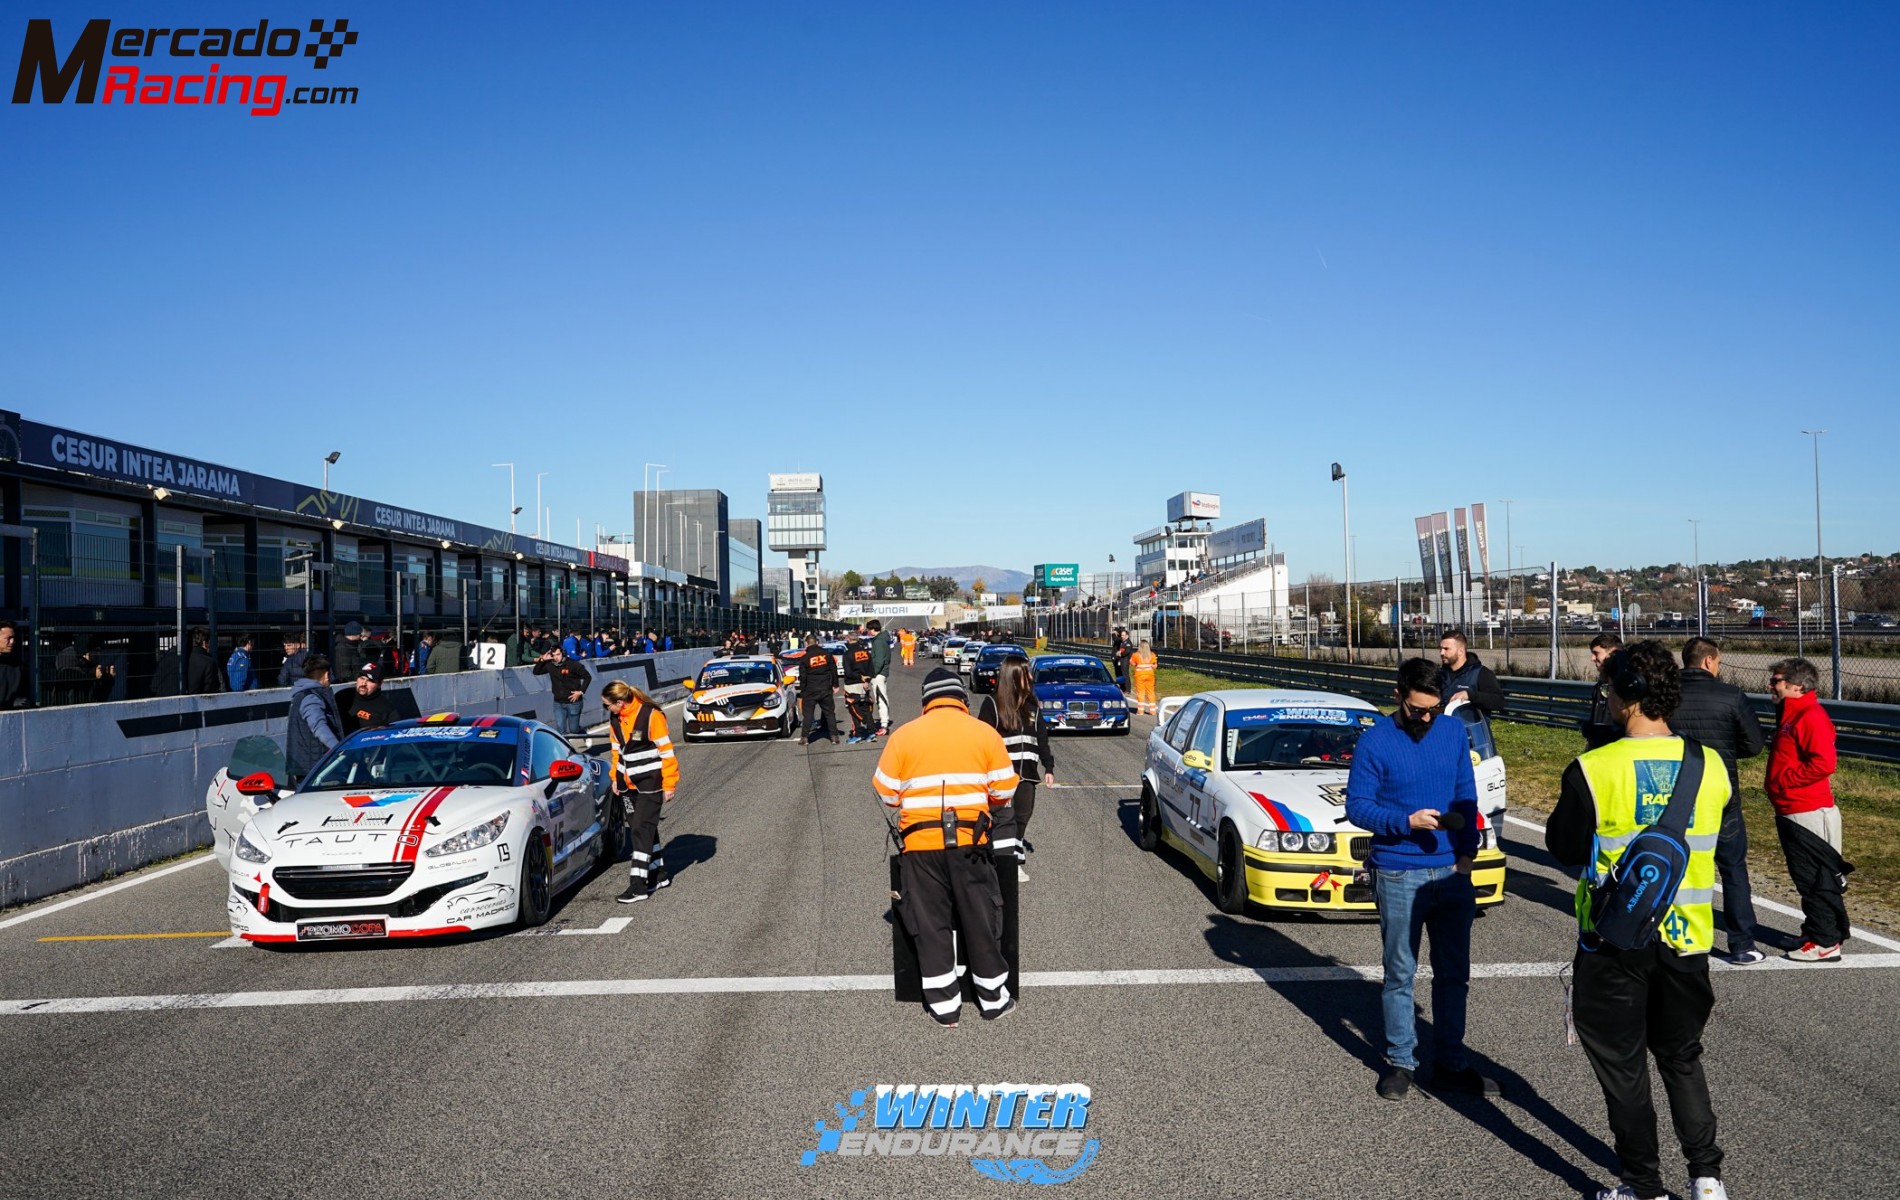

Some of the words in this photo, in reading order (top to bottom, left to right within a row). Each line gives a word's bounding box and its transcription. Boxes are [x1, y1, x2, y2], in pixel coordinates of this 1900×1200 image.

[51, 434, 118, 473] CESUR
[122, 450, 175, 485] INTEA
[177, 462, 240, 497] JARAMA
[375, 506, 402, 528] CESUR
[403, 512, 427, 533] INTEA
[427, 518, 456, 538] JARAMA
[536, 542, 550, 554] CESUR
[551, 545, 562, 558] INTEA
[562, 547, 577, 562] JARAMA
[1055, 567, 1074, 576] caser
[487, 646, 496, 666] 2
[809, 654, 827, 666] RX
[854, 650, 869, 660] RX
[1278, 714, 1347, 722] ENDURANCE
[1285, 708, 1347, 719] WINTER
[1626, 879, 1649, 912] KILOVIEW
[446, 915, 472, 924] CAR
[476, 902, 516, 919] MADRID
[307, 922, 385, 937] PROMOCOPA
